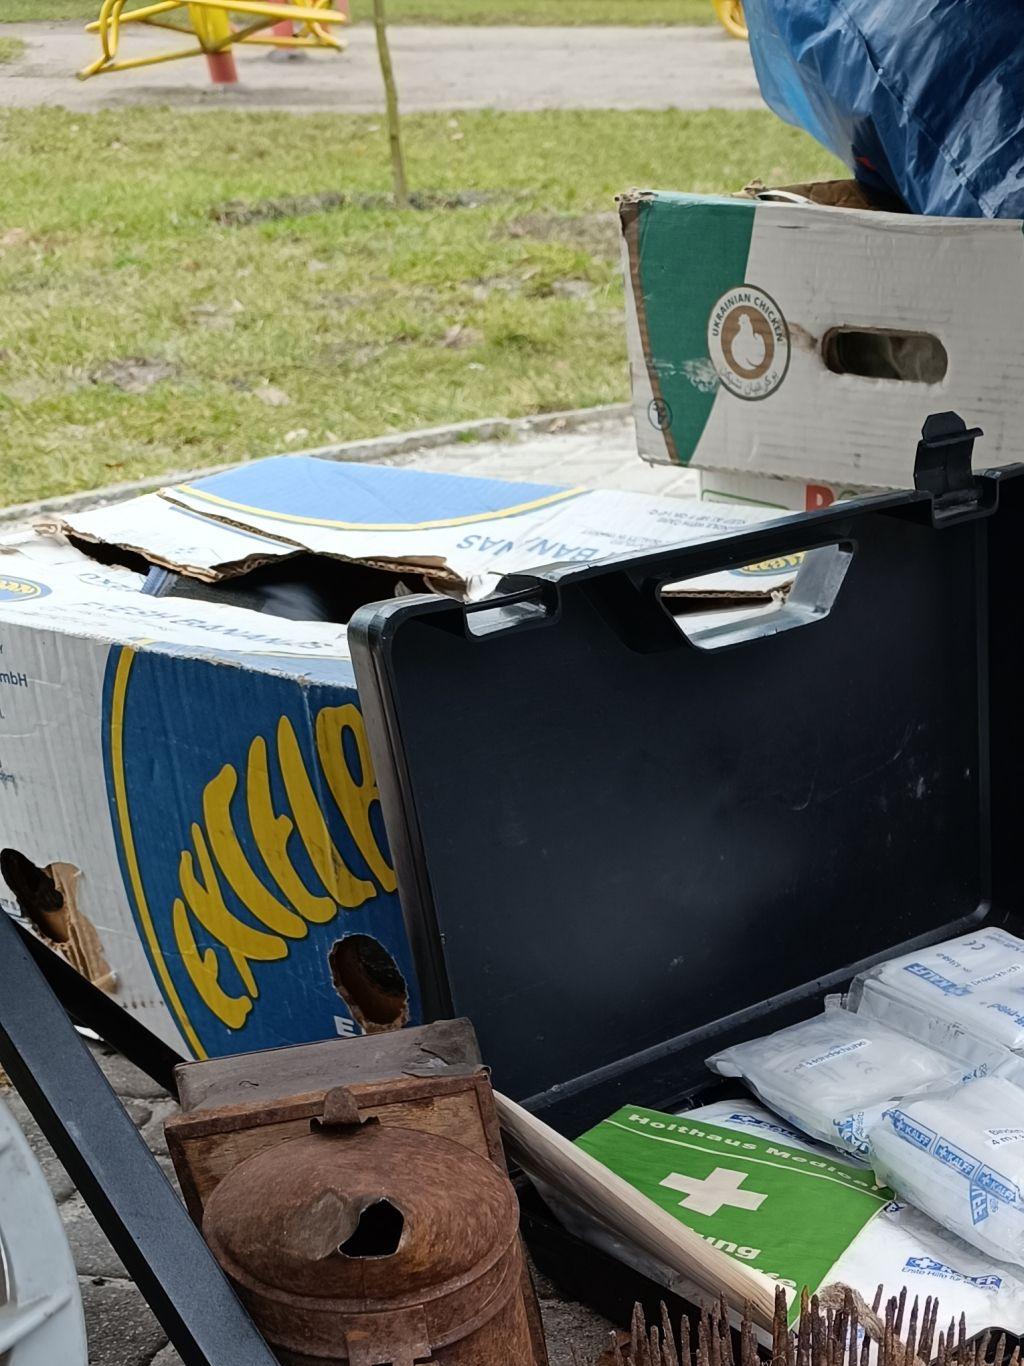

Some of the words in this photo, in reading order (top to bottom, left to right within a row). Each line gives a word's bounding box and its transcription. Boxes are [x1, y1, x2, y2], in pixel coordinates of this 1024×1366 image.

[712, 293, 751, 337] UKRAINIAN
[753, 297, 784, 342] CHICKEN
[456, 535, 600, 562] BANNAS
[628, 1113, 758, 1151] Holthaus
[904, 1123, 931, 1147] KALFF
[948, 1151, 975, 1176] KALFF
